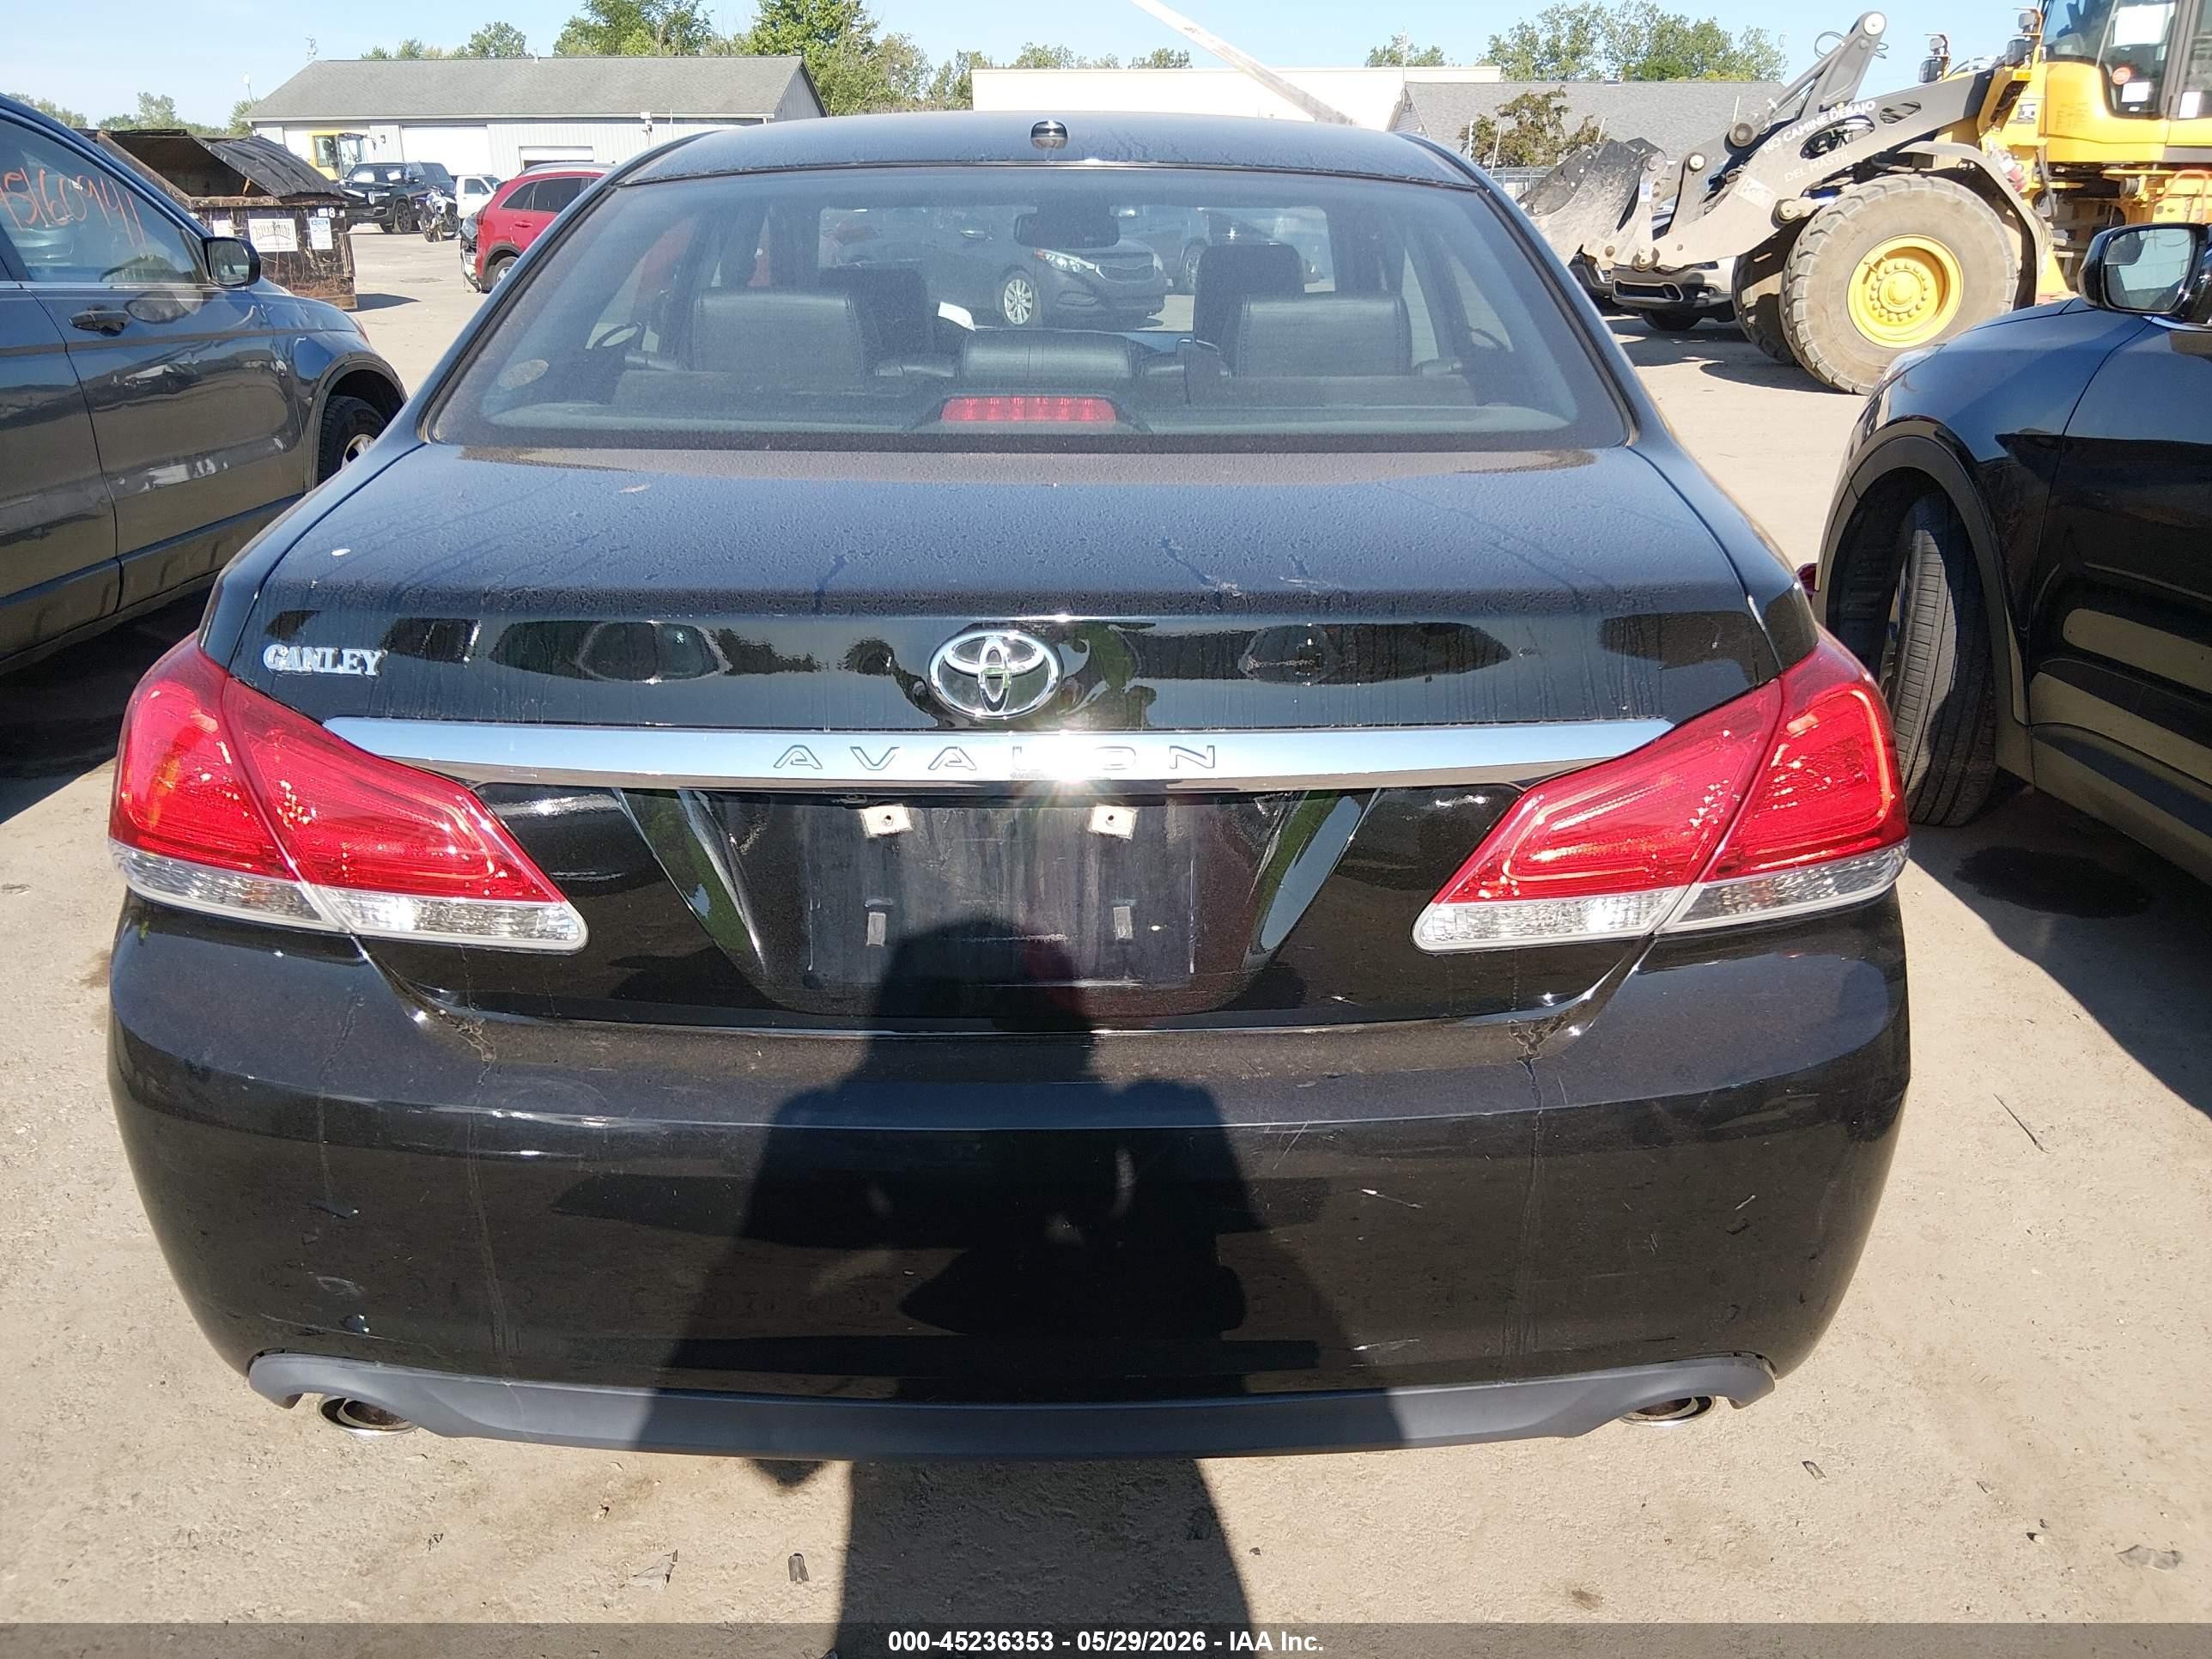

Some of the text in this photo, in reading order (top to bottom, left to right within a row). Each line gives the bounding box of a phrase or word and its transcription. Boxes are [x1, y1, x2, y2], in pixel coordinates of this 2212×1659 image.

[1762, 100, 1876, 155] NO CAMINE DEBAJO
[1784, 167, 1808, 183] DEL
[263, 644, 388, 677] GANLEY
